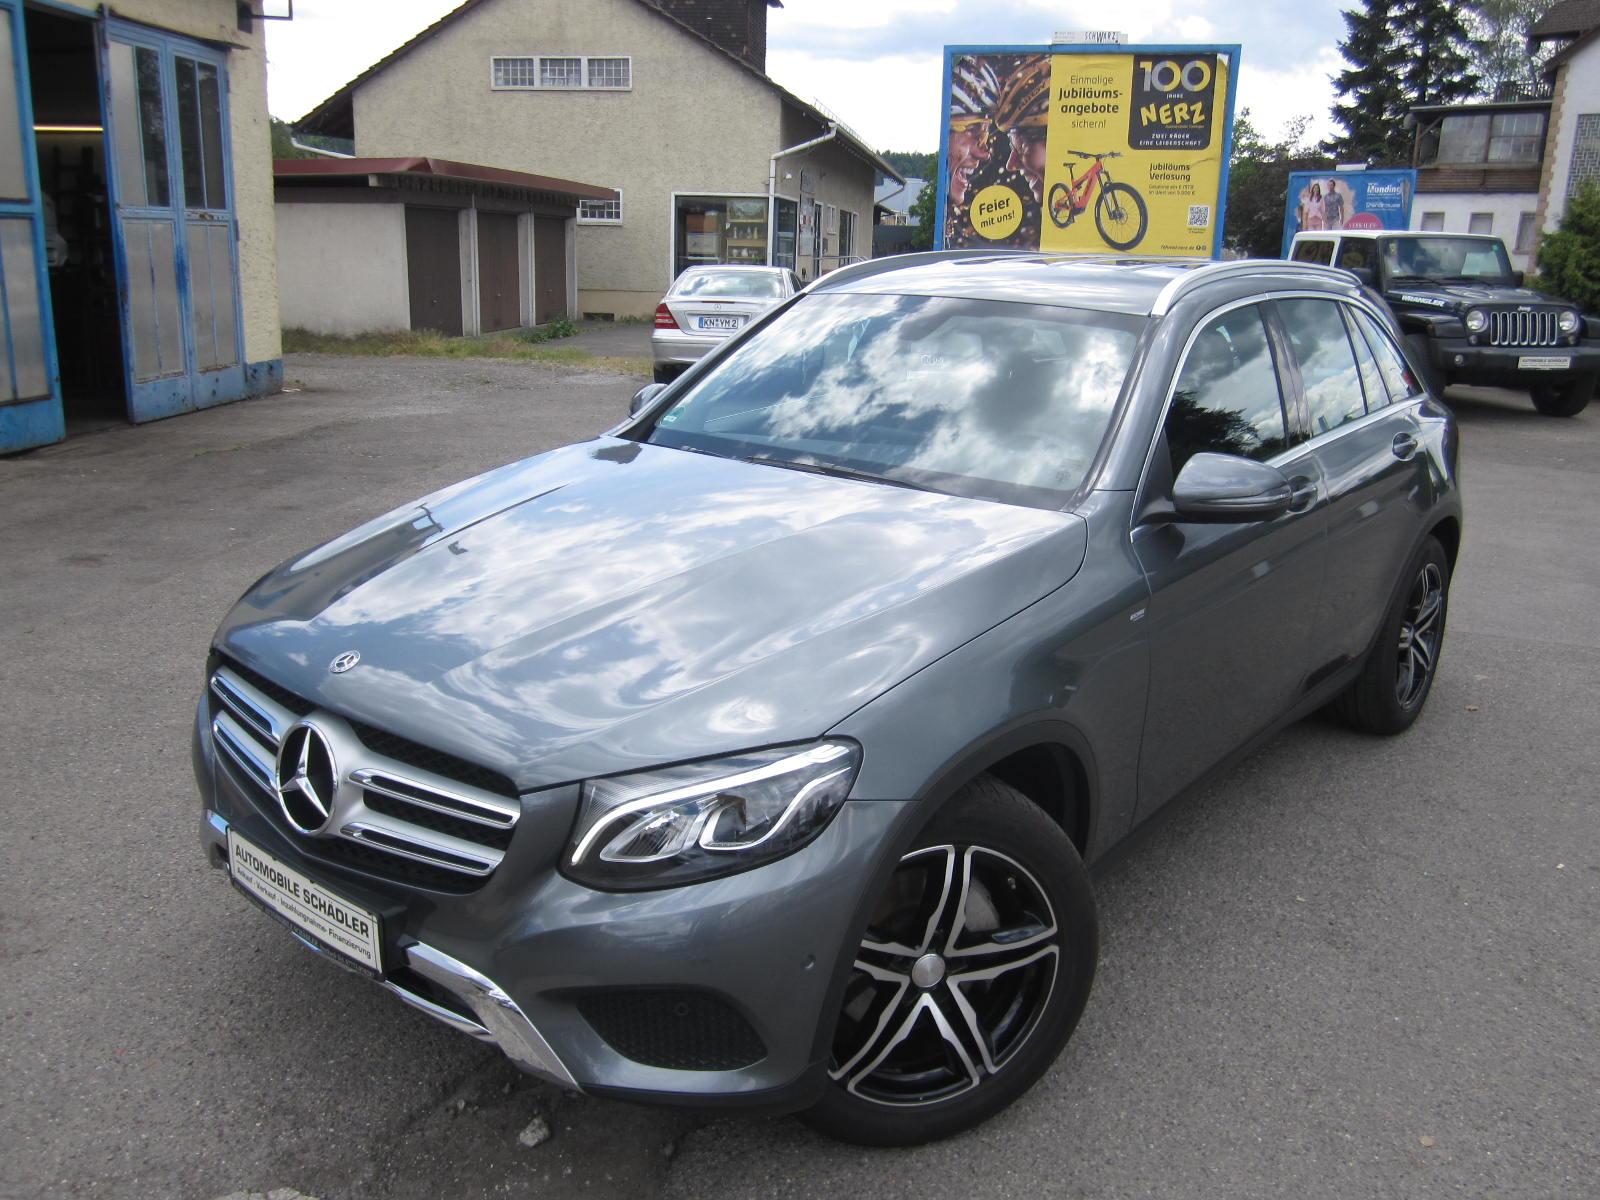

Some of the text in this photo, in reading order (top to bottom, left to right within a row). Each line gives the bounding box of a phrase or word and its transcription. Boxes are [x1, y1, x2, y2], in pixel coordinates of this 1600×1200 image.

[1070, 75, 1114, 85] Einmalige
[1140, 60, 1211, 92] 100
[1059, 87, 1122, 100] Jubiläums-
[1060, 102, 1119, 116] angebote
[1140, 101, 1206, 127] NERZ
[1071, 119, 1106, 129] sichern!
[1149, 162, 1191, 171] Jubiläums
[1149, 173, 1191, 182] Verlosung
[978, 197, 1010, 216] Feier
[980, 210, 1015, 228] mit uns!
[1401, 294, 1446, 307] WRANGLER
[703, 318, 715, 328] KN
[235, 844, 369, 938] AUTOMOBILE SCHÄDLER
[328, 928, 372, 959] Finanzierung
